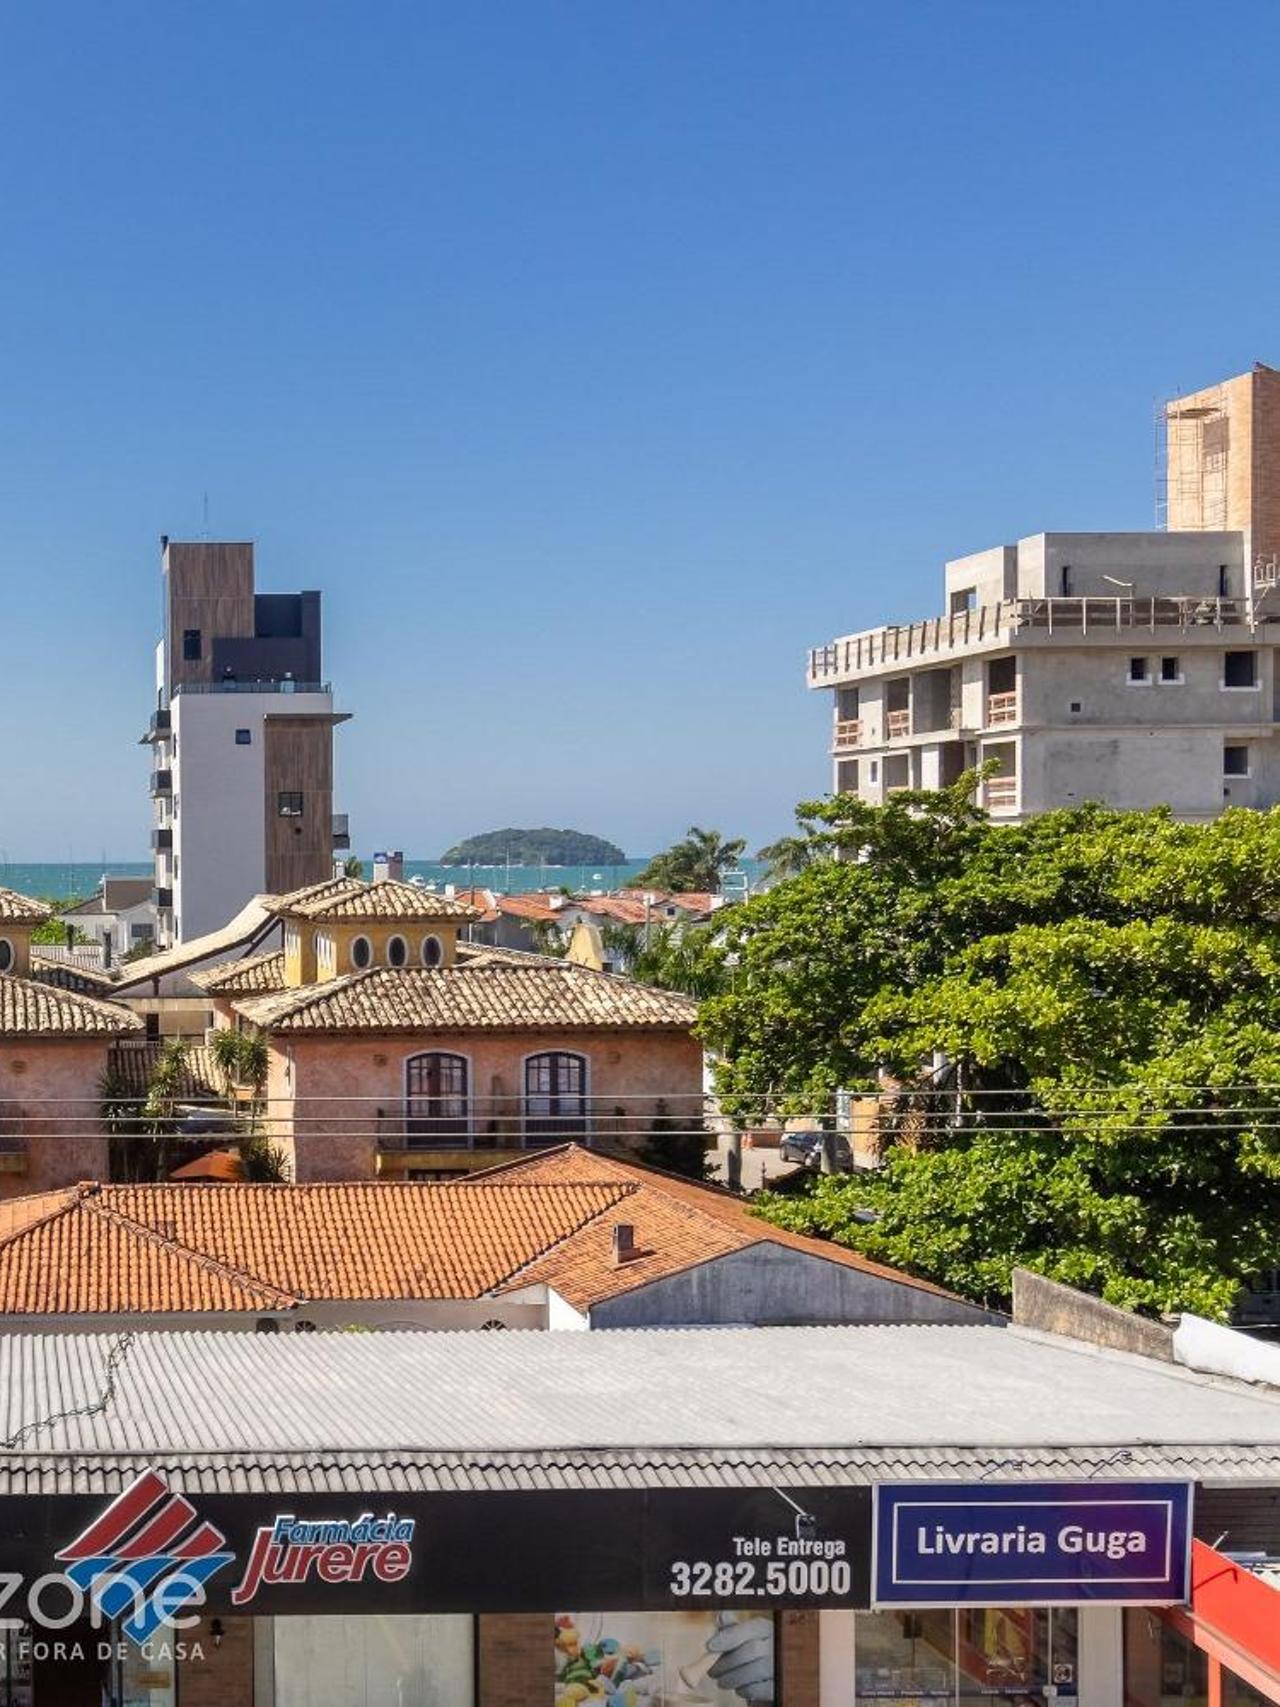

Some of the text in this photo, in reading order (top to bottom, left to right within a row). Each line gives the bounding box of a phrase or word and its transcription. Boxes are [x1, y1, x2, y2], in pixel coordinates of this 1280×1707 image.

[272, 1513, 416, 1543] Farmácia
[917, 1525, 1146, 1560] Livraria Guga
[732, 1537, 846, 1559] Tele Entrega
[670, 1561, 851, 1596] 3282.5000
